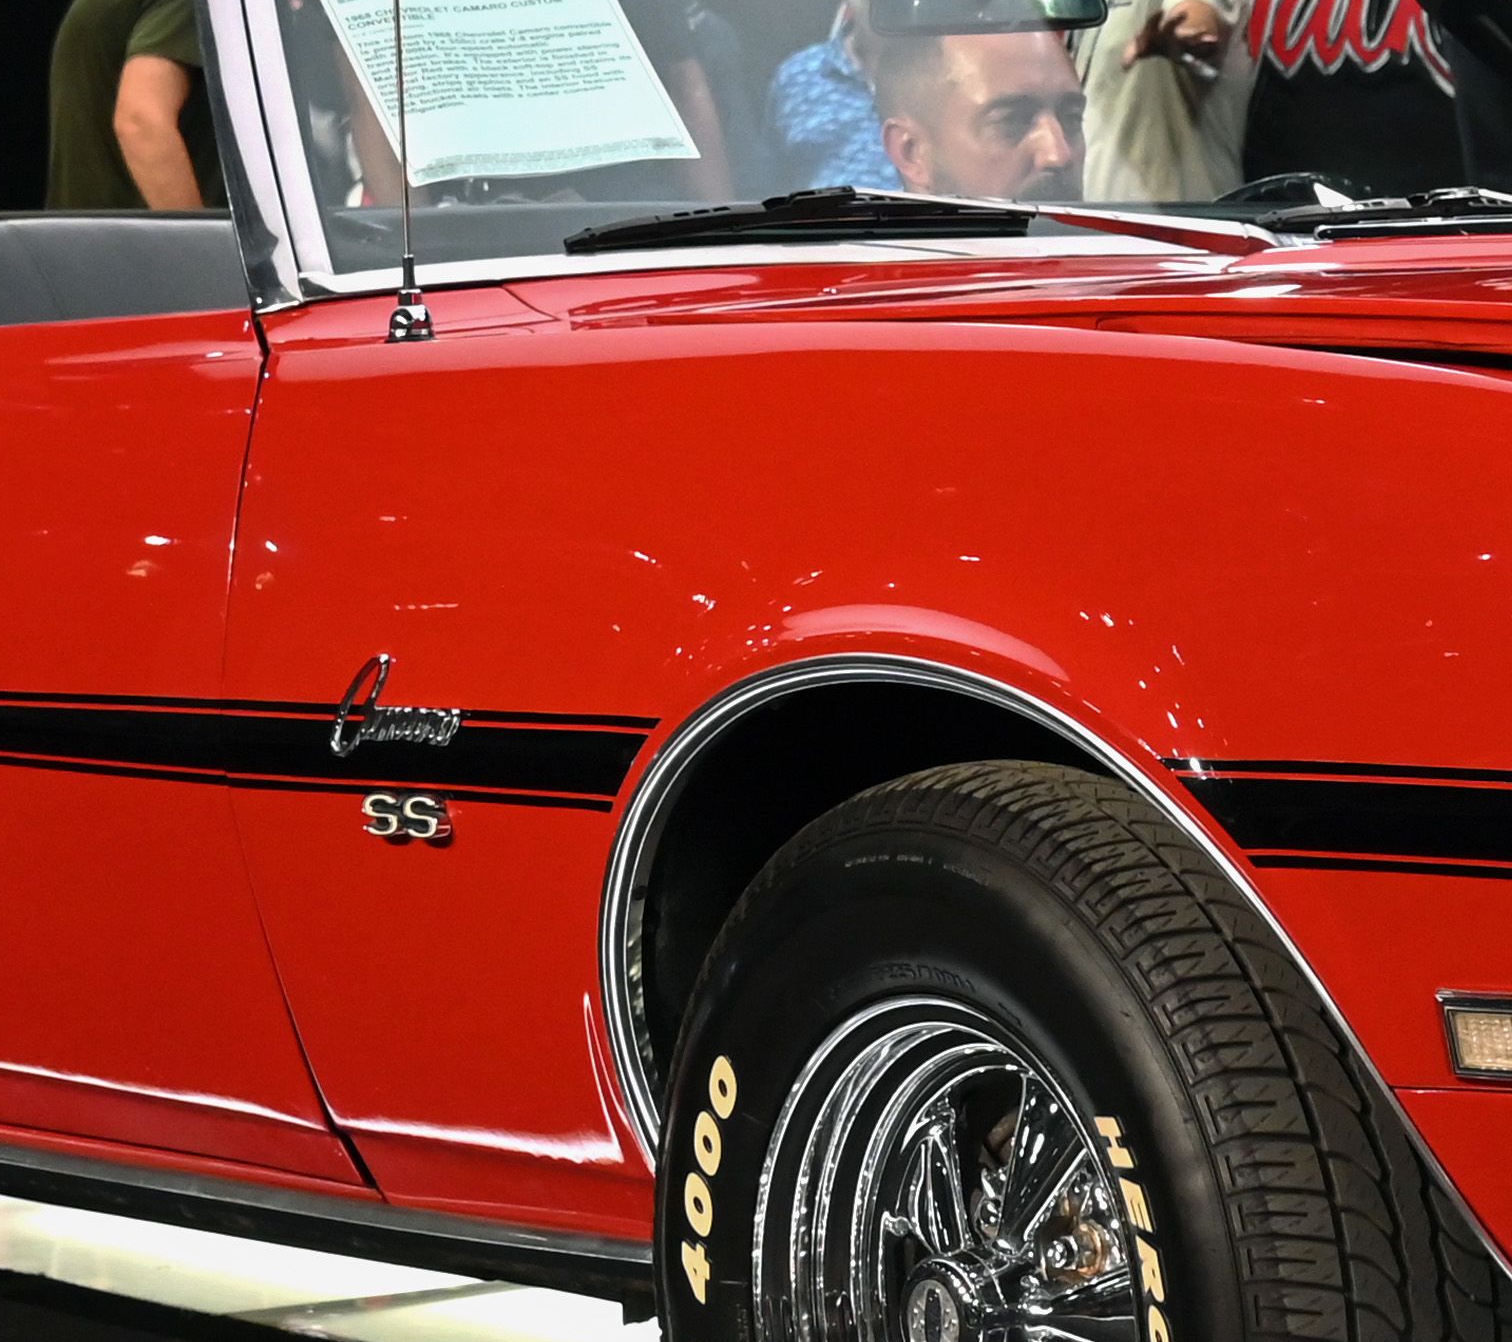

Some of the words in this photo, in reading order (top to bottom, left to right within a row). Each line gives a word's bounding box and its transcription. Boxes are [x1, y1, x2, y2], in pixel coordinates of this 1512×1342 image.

[375, 7, 448, 16] CHVROLET
[362, 792, 450, 841] SS
[680, 1054, 737, 1306] 4000
